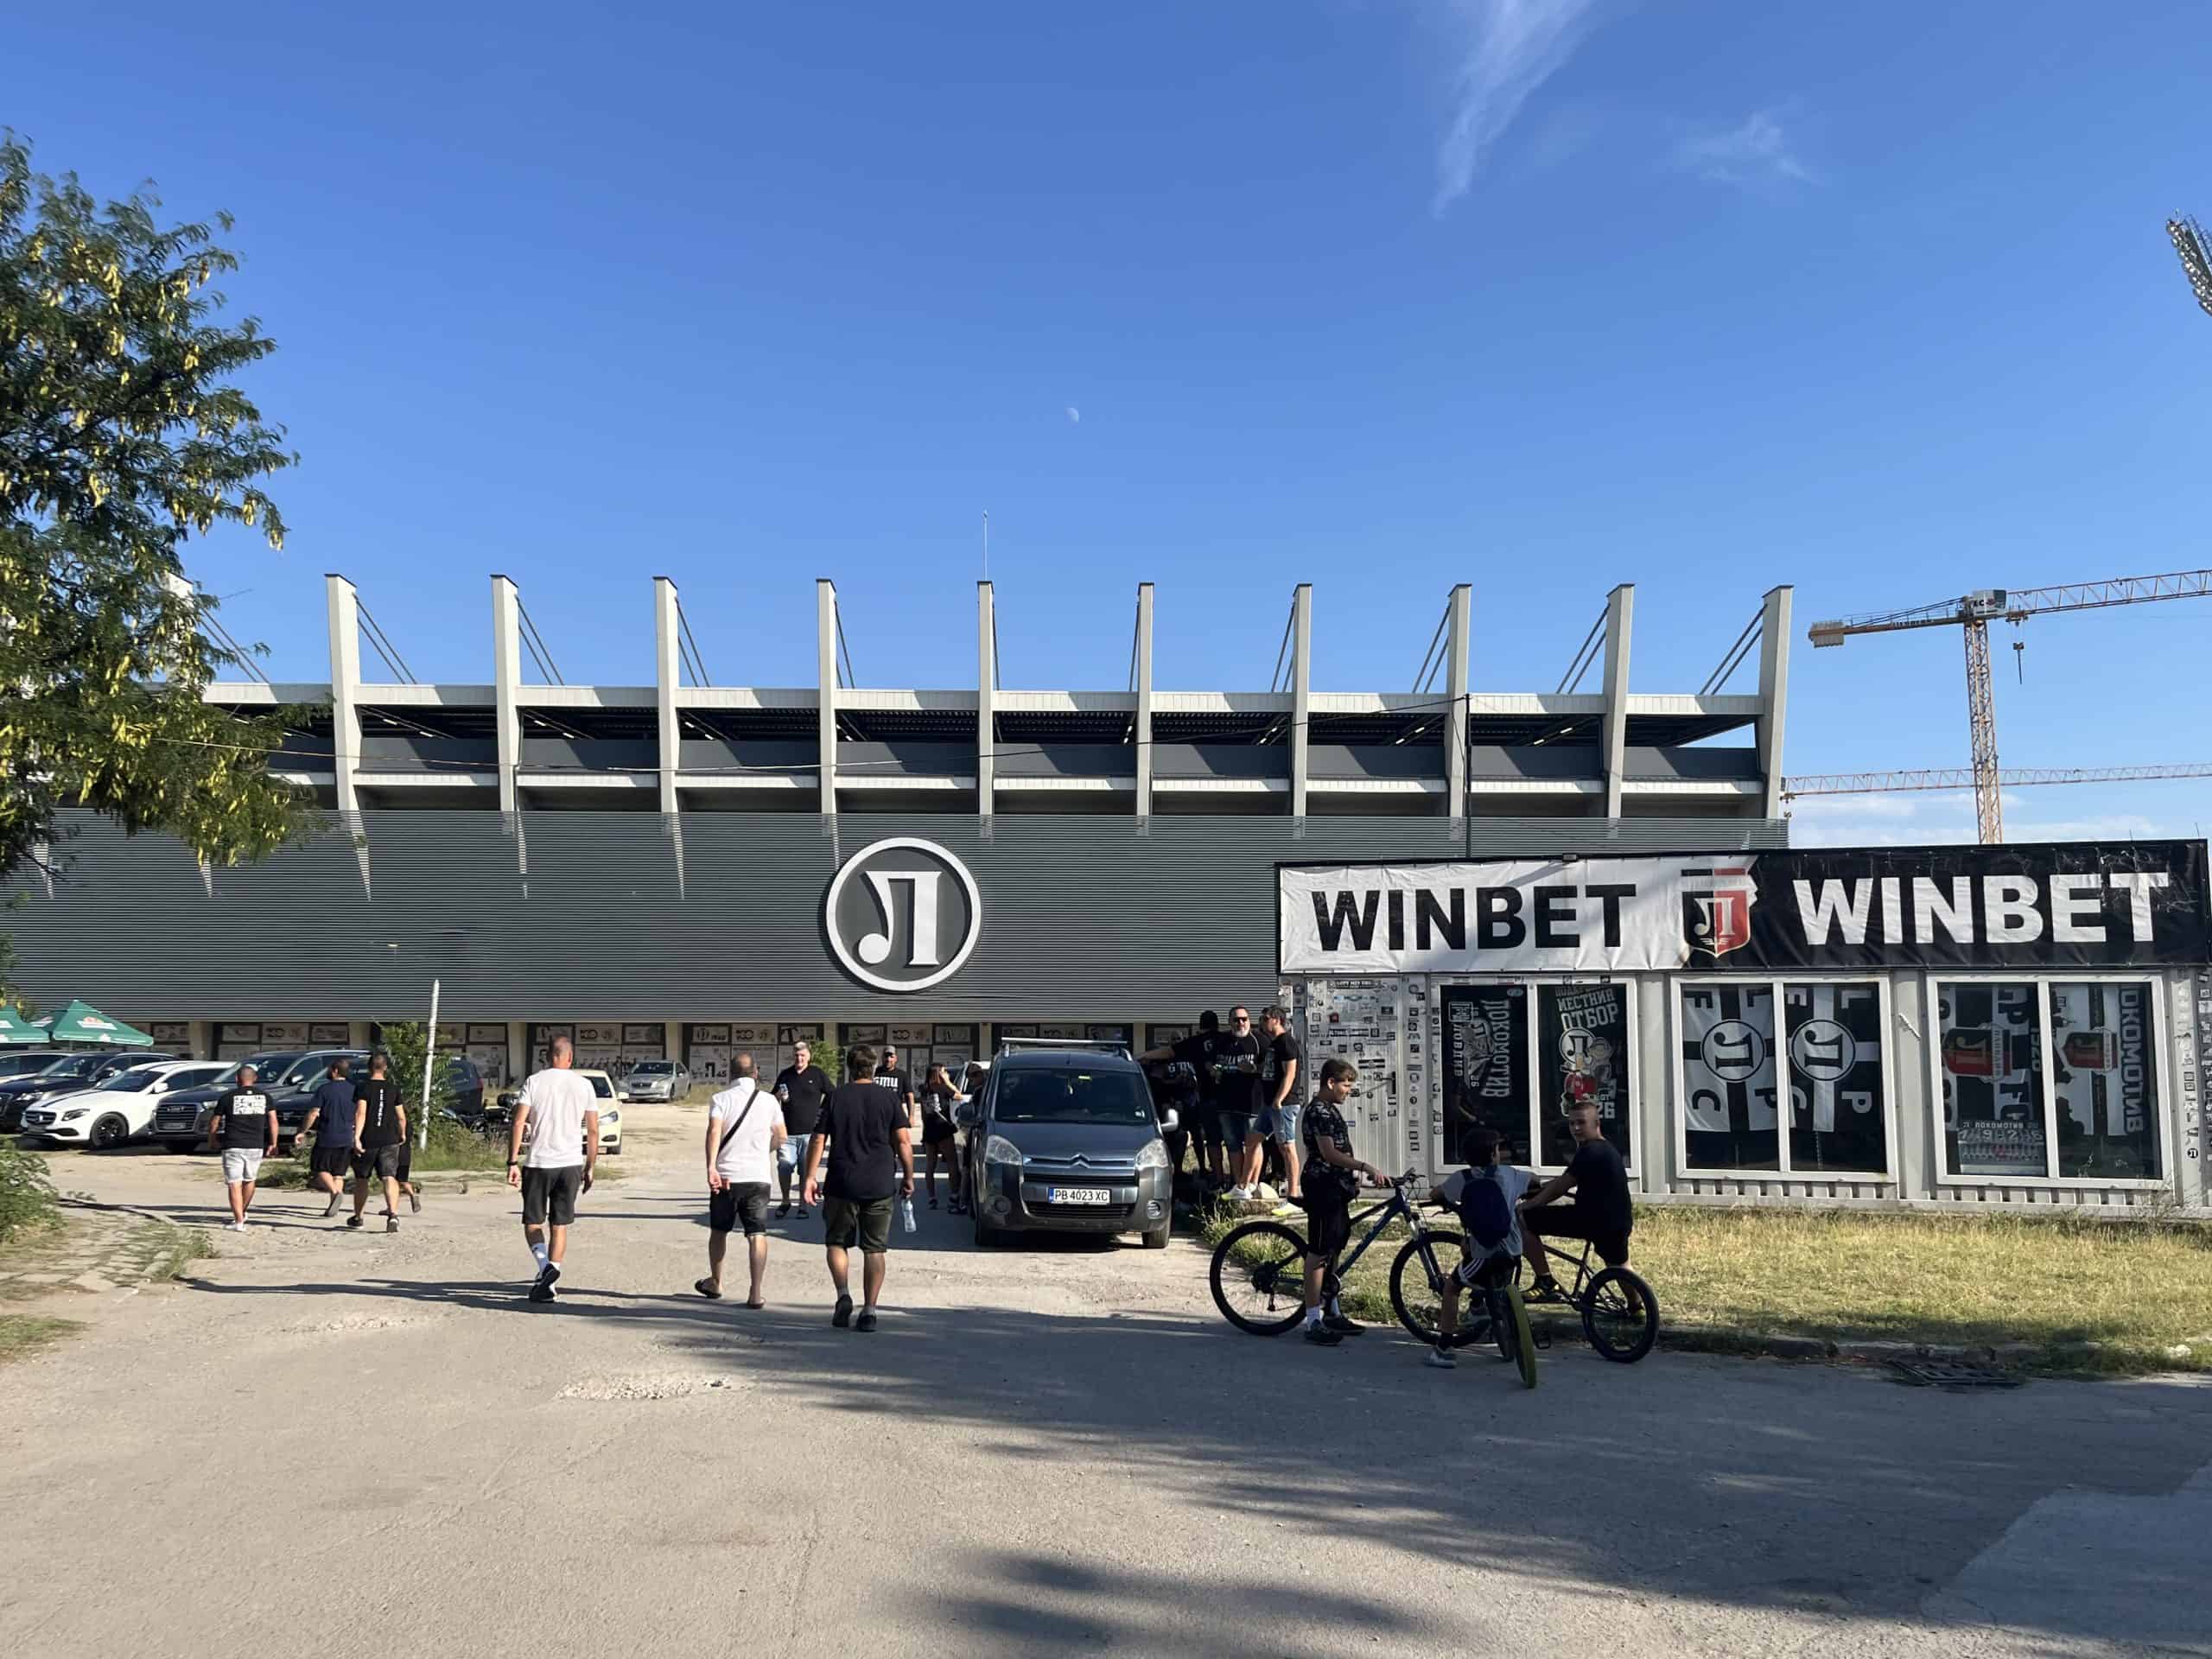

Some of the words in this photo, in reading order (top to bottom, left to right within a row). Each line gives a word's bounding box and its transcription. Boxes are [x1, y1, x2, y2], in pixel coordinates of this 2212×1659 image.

[1311, 883, 1637, 952] WINBET
[1793, 872, 2170, 945] WINBET
[1480, 1000, 1510, 1098] ЛОКОМОТИВ
[1560, 1002, 1618, 1031] ОТБОР
[2120, 989, 2144, 1133] ОКОМОТИВ
[1055, 1190, 1068, 1200] PB
[1070, 1191, 1094, 1201] 4023
[1096, 1192, 1108, 1201] XC
